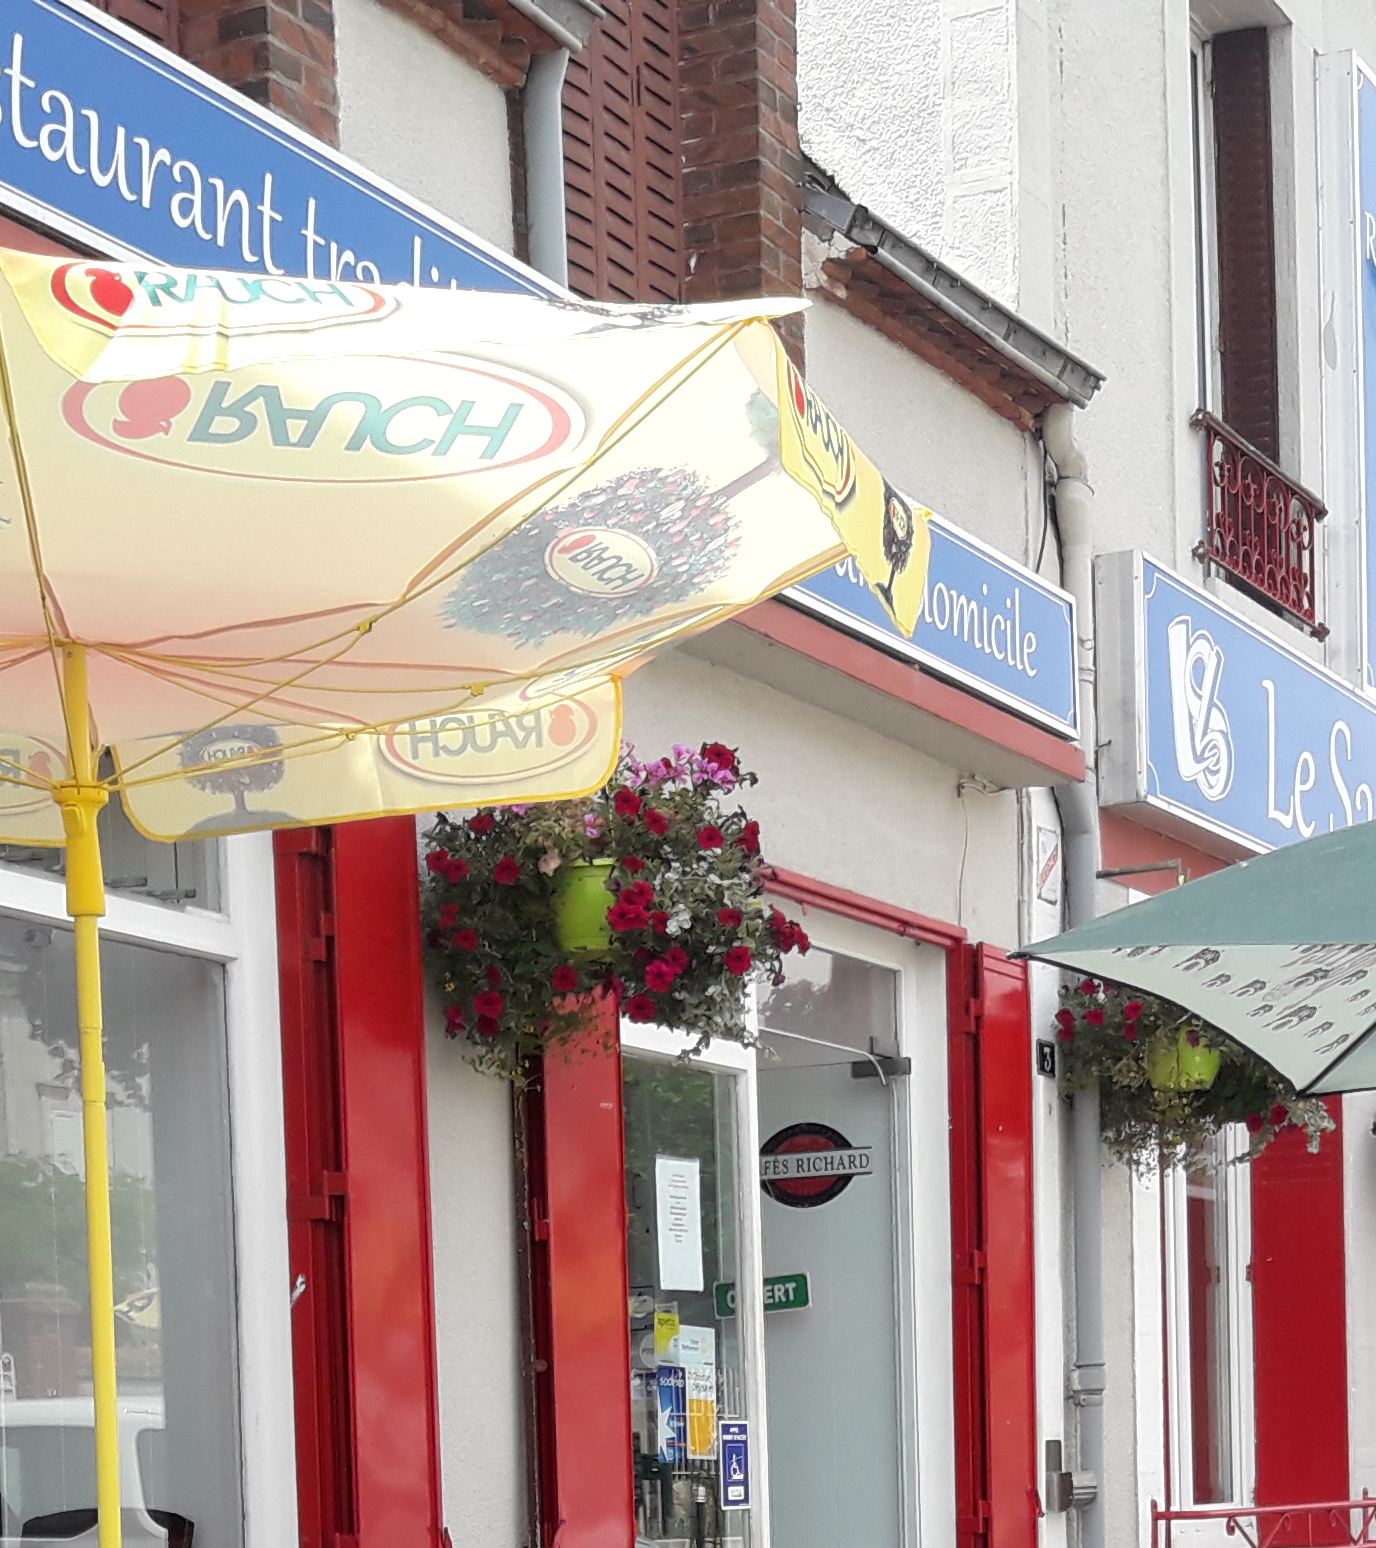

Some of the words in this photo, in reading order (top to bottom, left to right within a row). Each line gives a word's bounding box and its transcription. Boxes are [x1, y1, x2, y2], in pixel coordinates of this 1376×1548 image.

[133, 271, 355, 307] RAUCH
[1262, 679, 1316, 838] Le
[1043, 1047, 1052, 1072] 3
[796, 1154, 870, 1174] RICHARD
[727, 1282, 797, 1309] OERT
